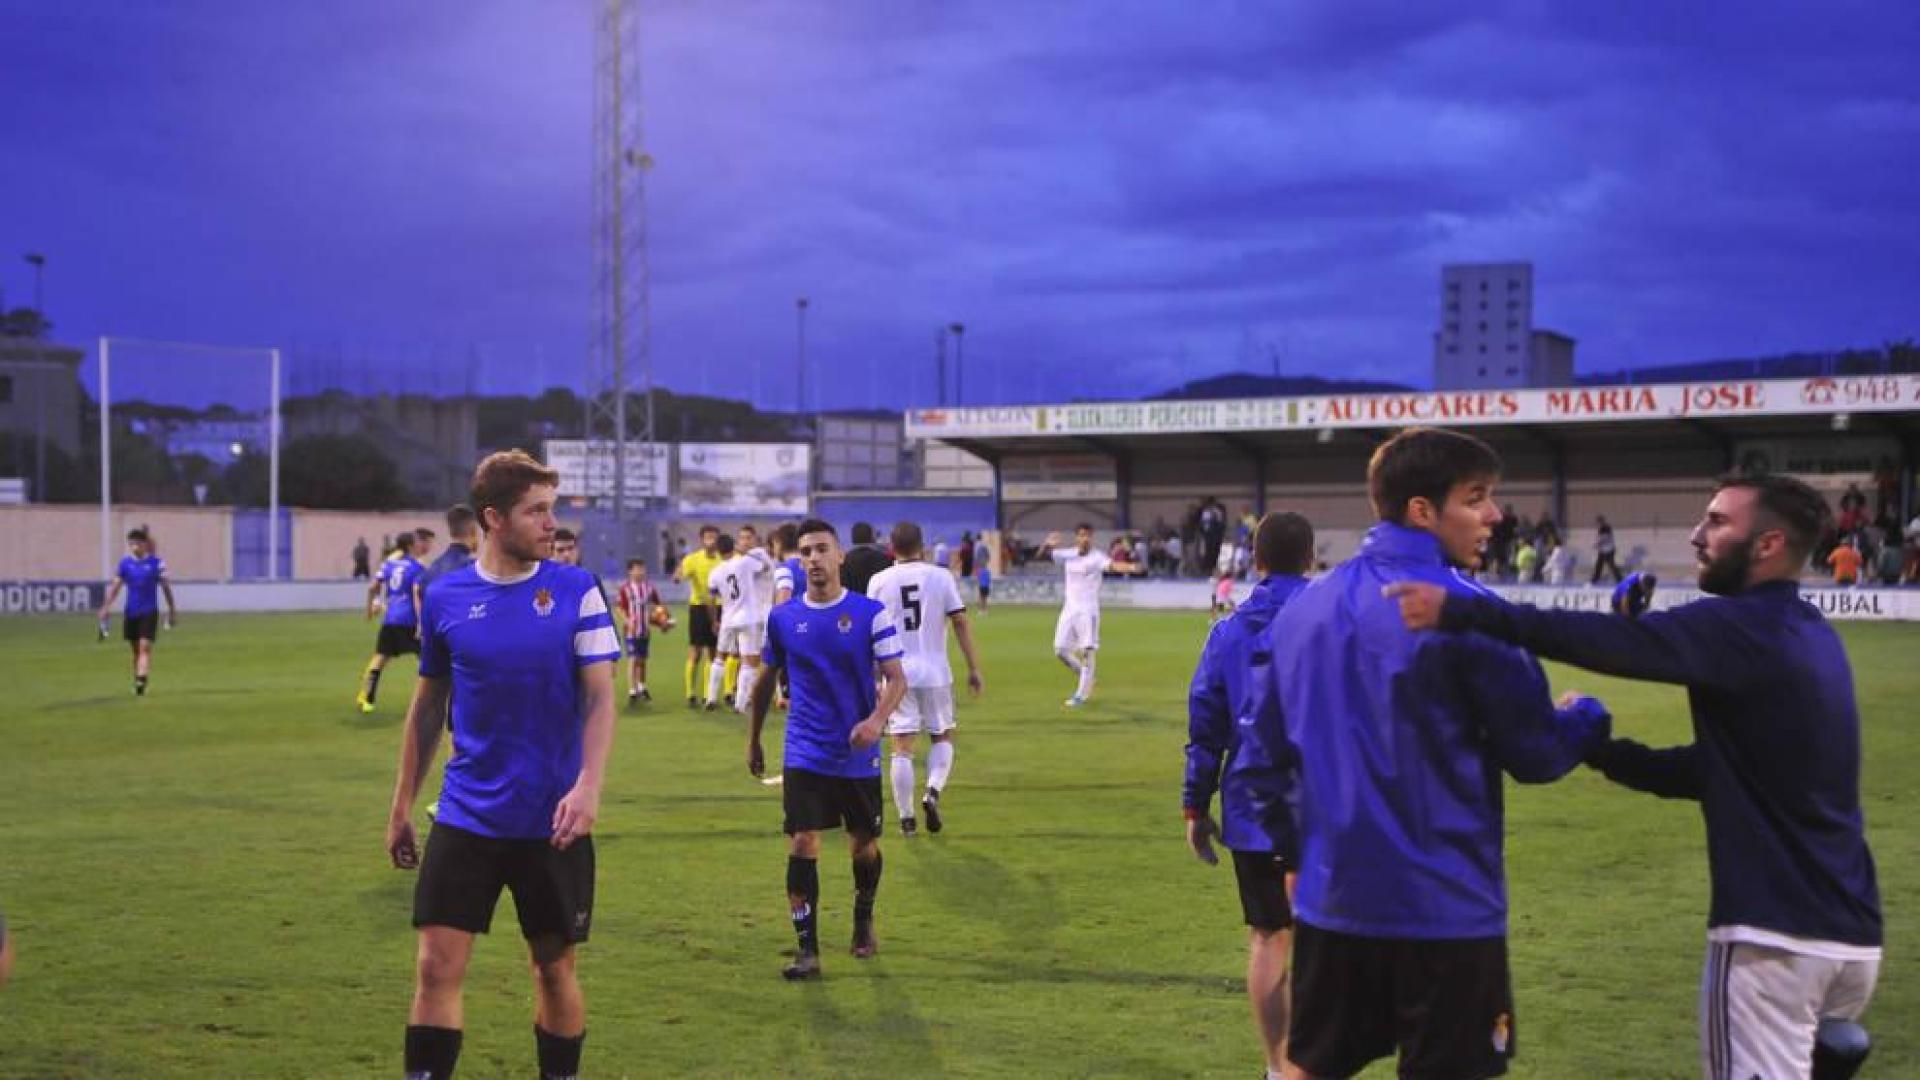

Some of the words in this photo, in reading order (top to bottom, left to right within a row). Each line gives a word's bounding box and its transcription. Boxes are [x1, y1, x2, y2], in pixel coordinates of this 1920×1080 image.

[1322, 391, 1519, 421] AUTOCARES
[1546, 387, 1656, 414] MARIA
[1669, 382, 1765, 418] JOSE
[1844, 377, 1900, 404] 948
[0, 586, 90, 612] DICOA
[727, 574, 741, 600] 3
[901, 584, 922, 631] 5
